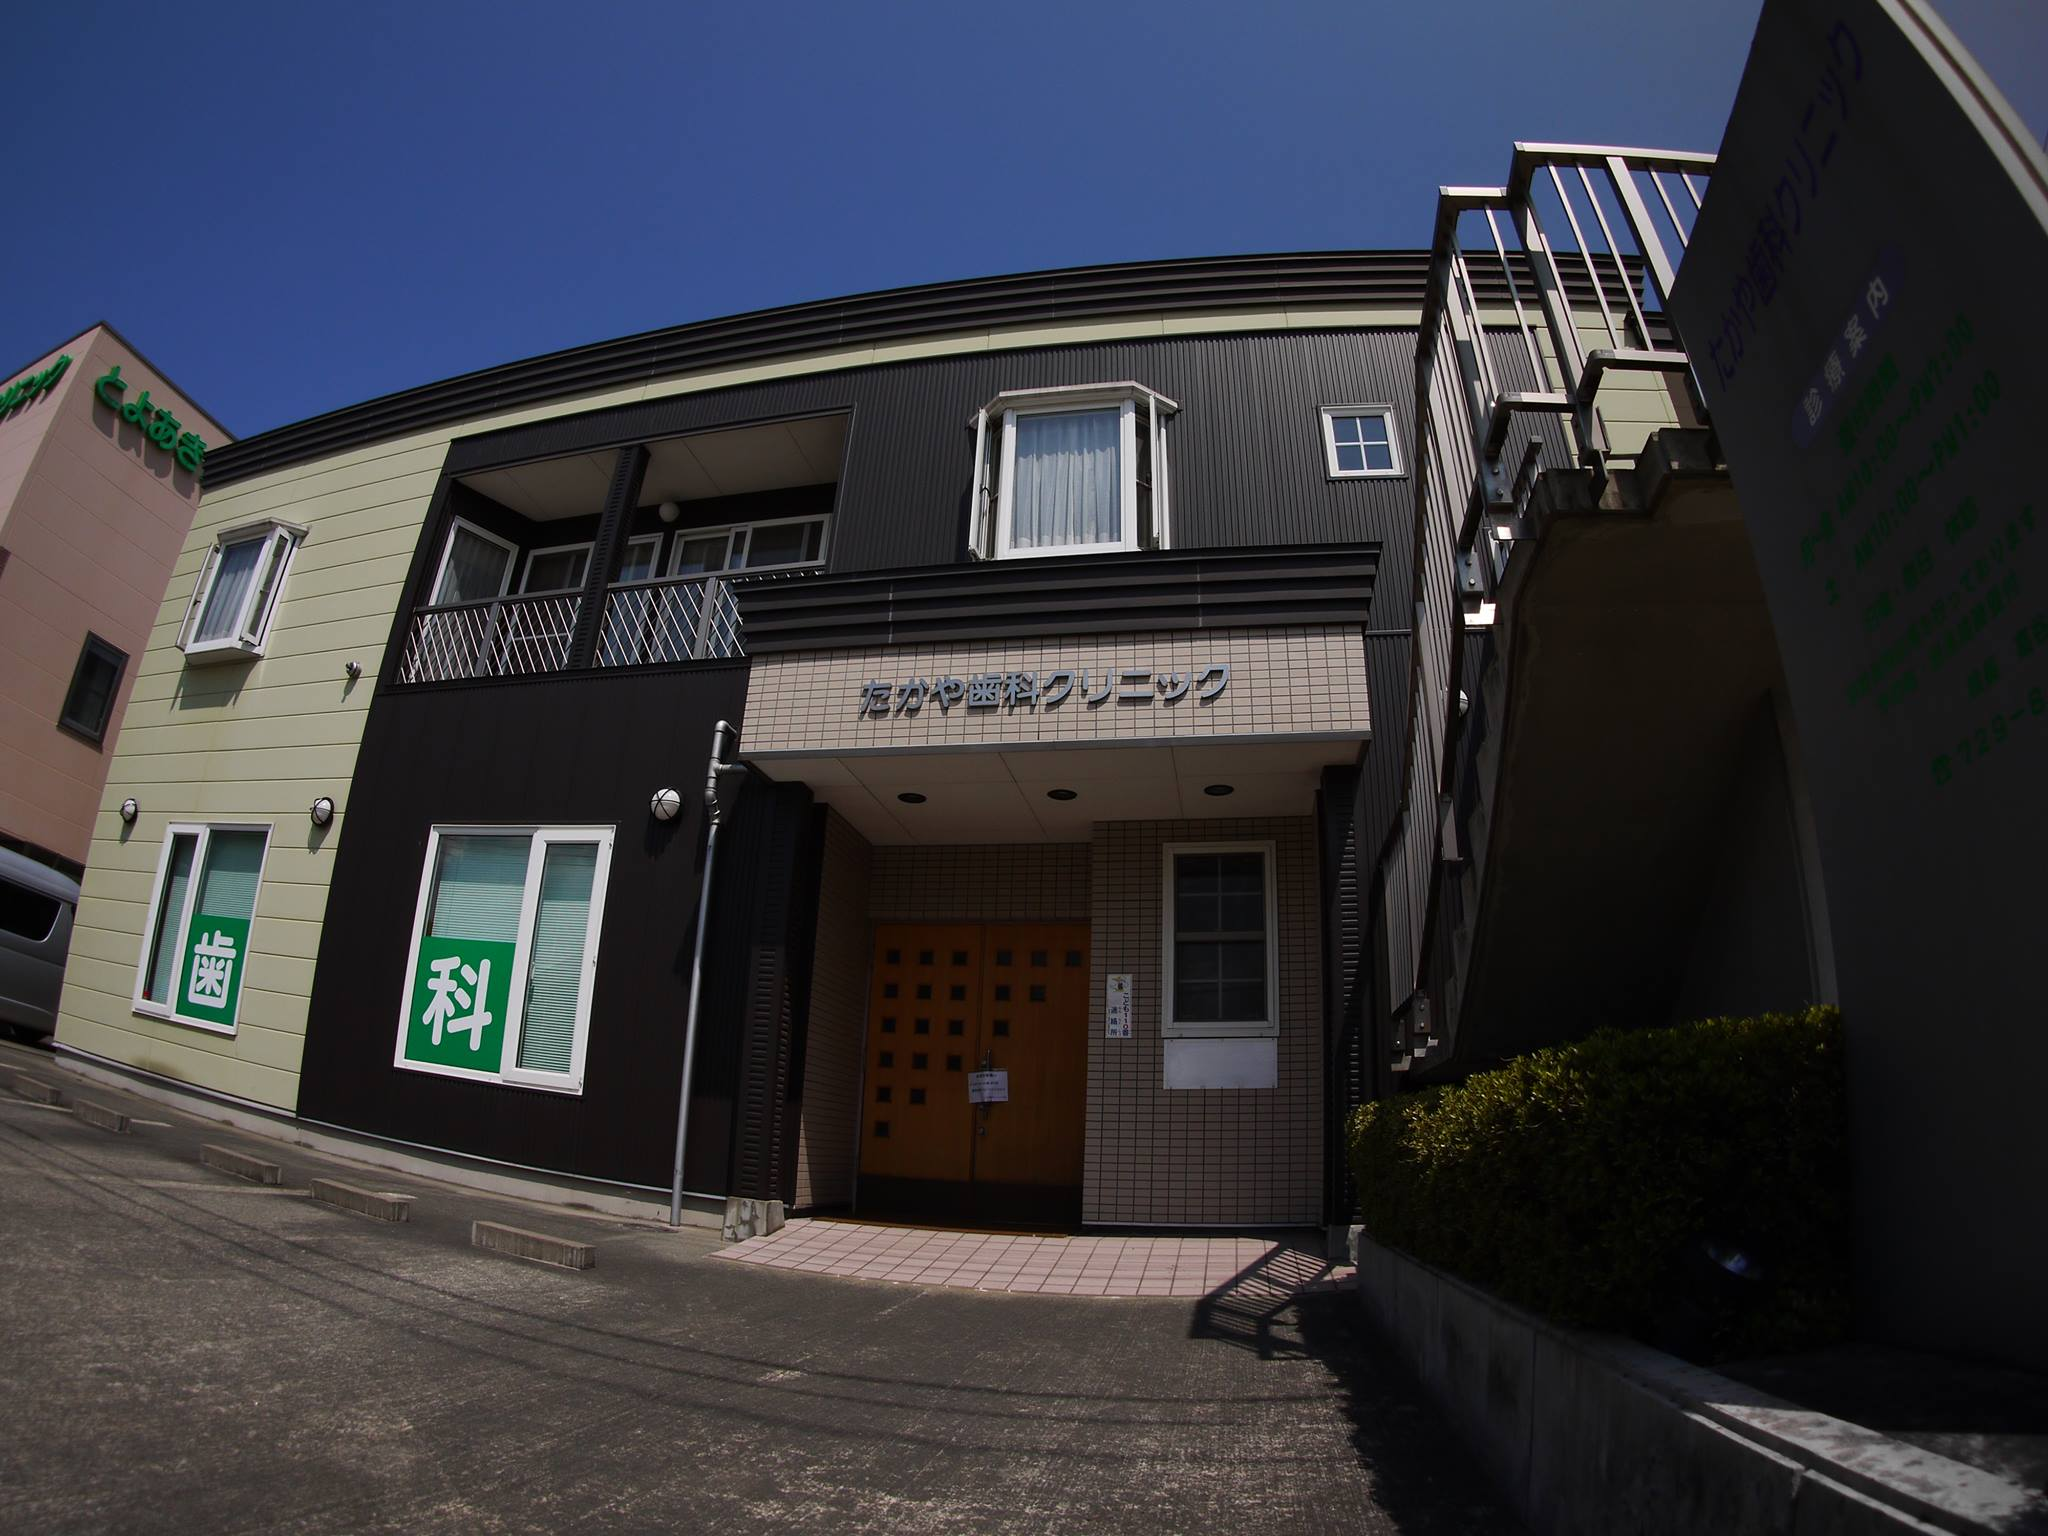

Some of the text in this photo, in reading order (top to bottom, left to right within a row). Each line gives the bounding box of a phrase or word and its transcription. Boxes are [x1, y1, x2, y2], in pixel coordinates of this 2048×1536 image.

[1709, 19, 1862, 392] たかや歯科クリニック
[0, 354, 72, 417] リニック
[1803, 276, 1888, 426] 診療案内
[95, 366, 207, 475] とよあき
[860, 663, 1231, 713] たかや歯科クリニック
[188, 929, 237, 1009] 歯
[423, 956, 492, 1051] 科
